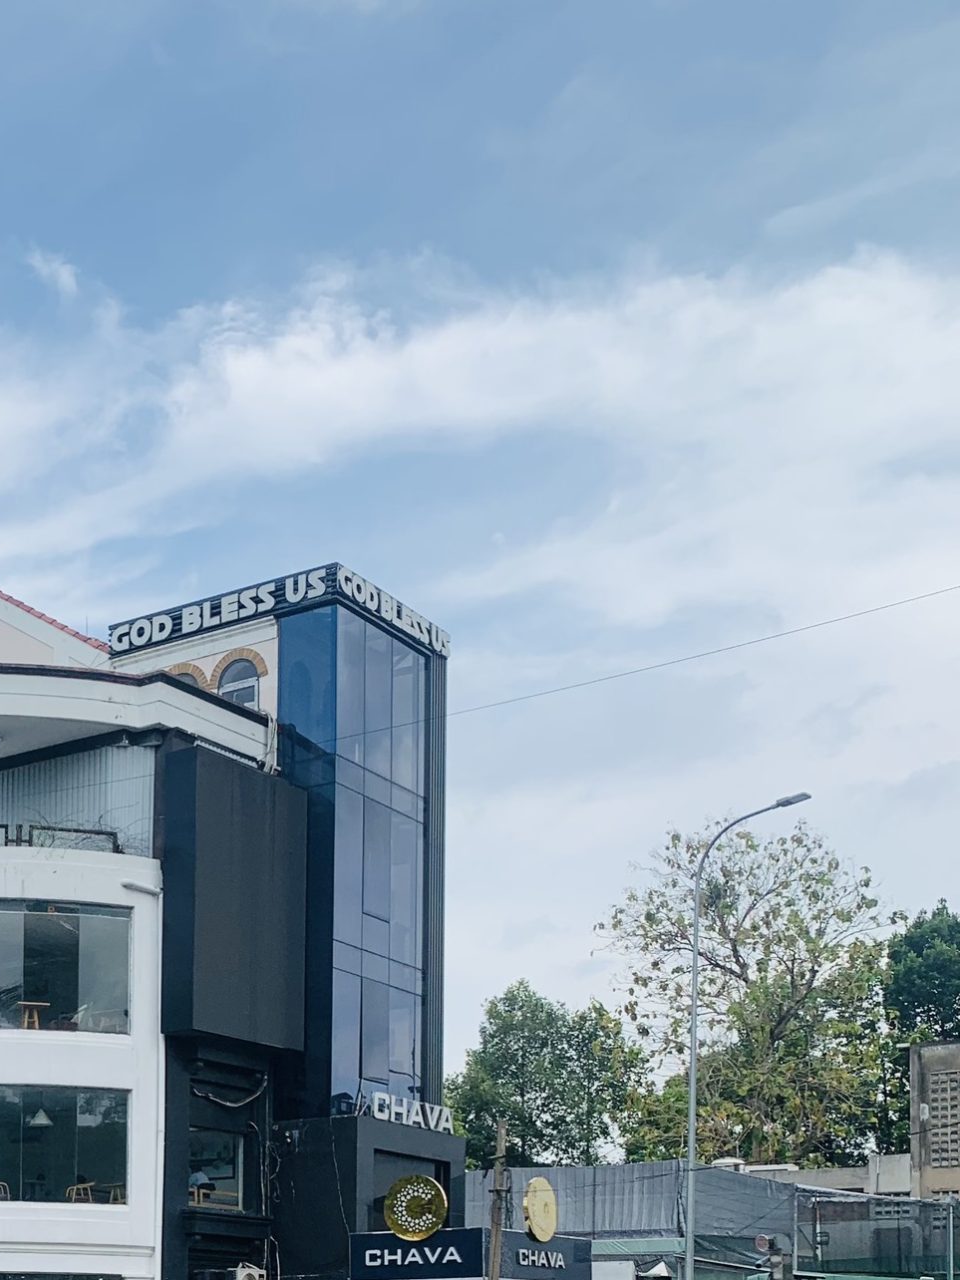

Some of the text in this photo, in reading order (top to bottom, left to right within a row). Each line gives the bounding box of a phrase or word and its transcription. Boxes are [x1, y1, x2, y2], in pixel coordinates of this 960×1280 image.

[111, 568, 326, 652] GOD BLESS US
[337, 566, 379, 614] GOD
[381, 590, 431, 646] BLESS
[373, 1091, 454, 1135] CHAVA
[365, 1246, 463, 1267] CHAVA
[518, 1248, 565, 1269] CHAVA
